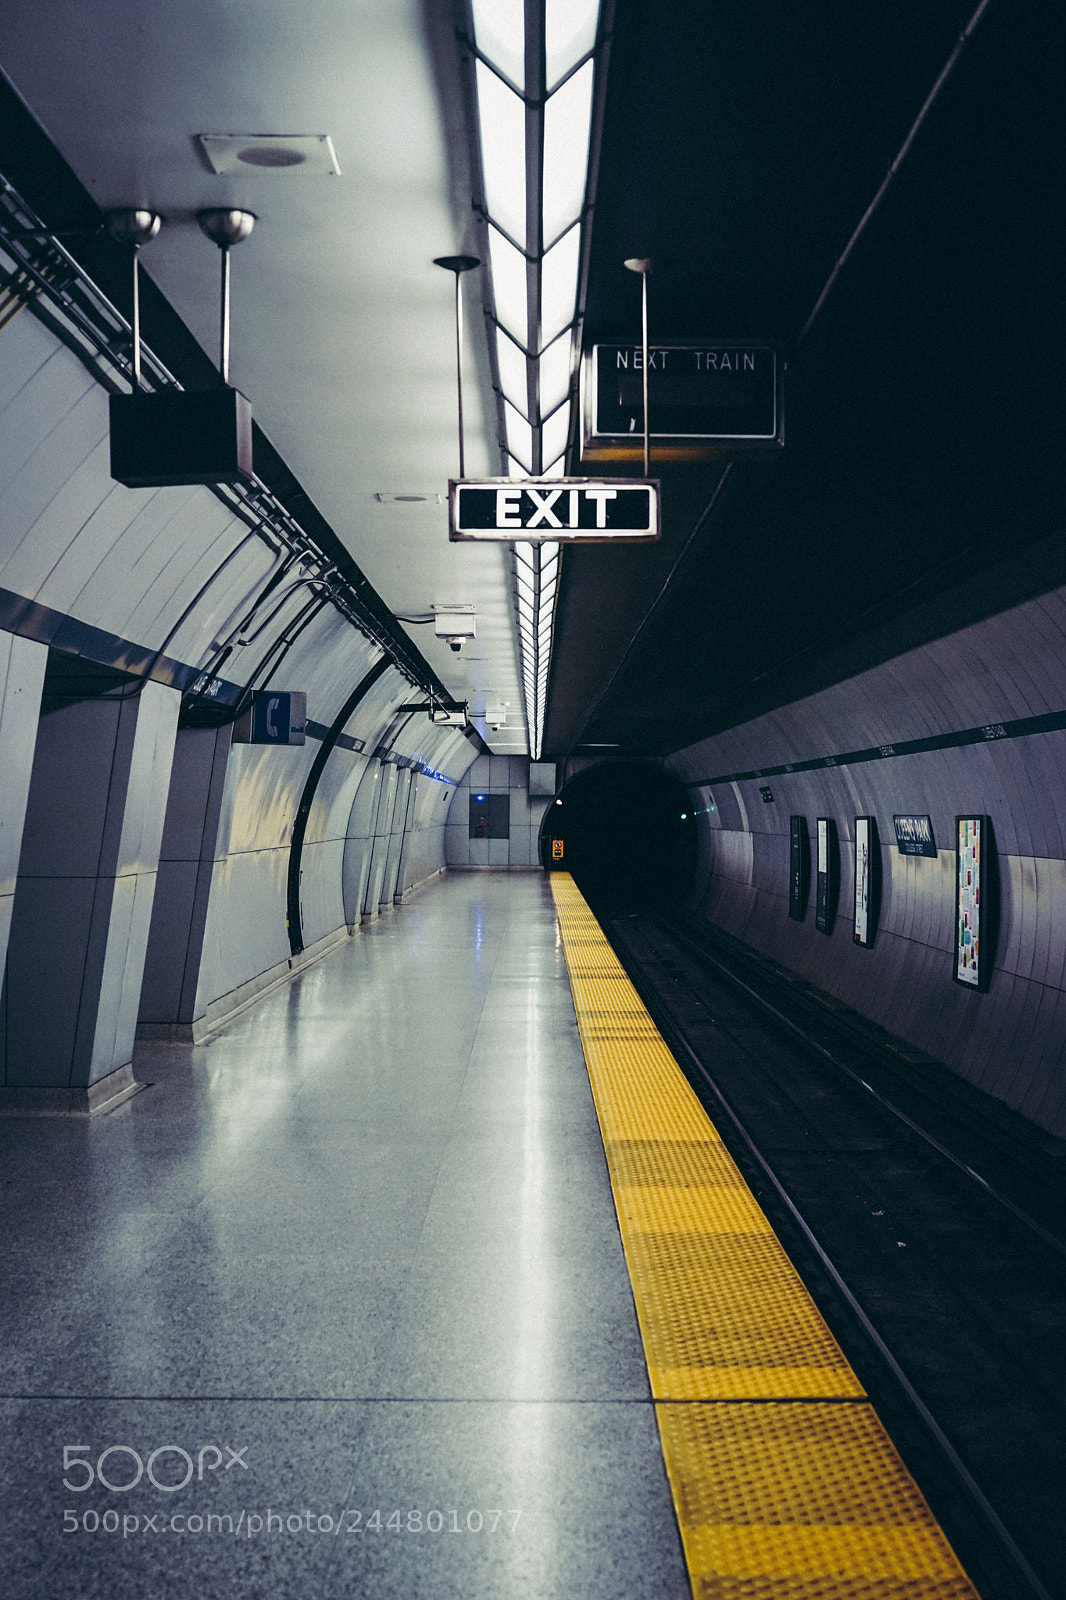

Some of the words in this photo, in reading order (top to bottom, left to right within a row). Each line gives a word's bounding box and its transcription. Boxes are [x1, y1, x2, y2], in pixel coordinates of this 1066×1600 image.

[616, 350, 669, 370] NEXT
[694, 351, 756, 371] TRAIN
[496, 489, 618, 529] EXIT
